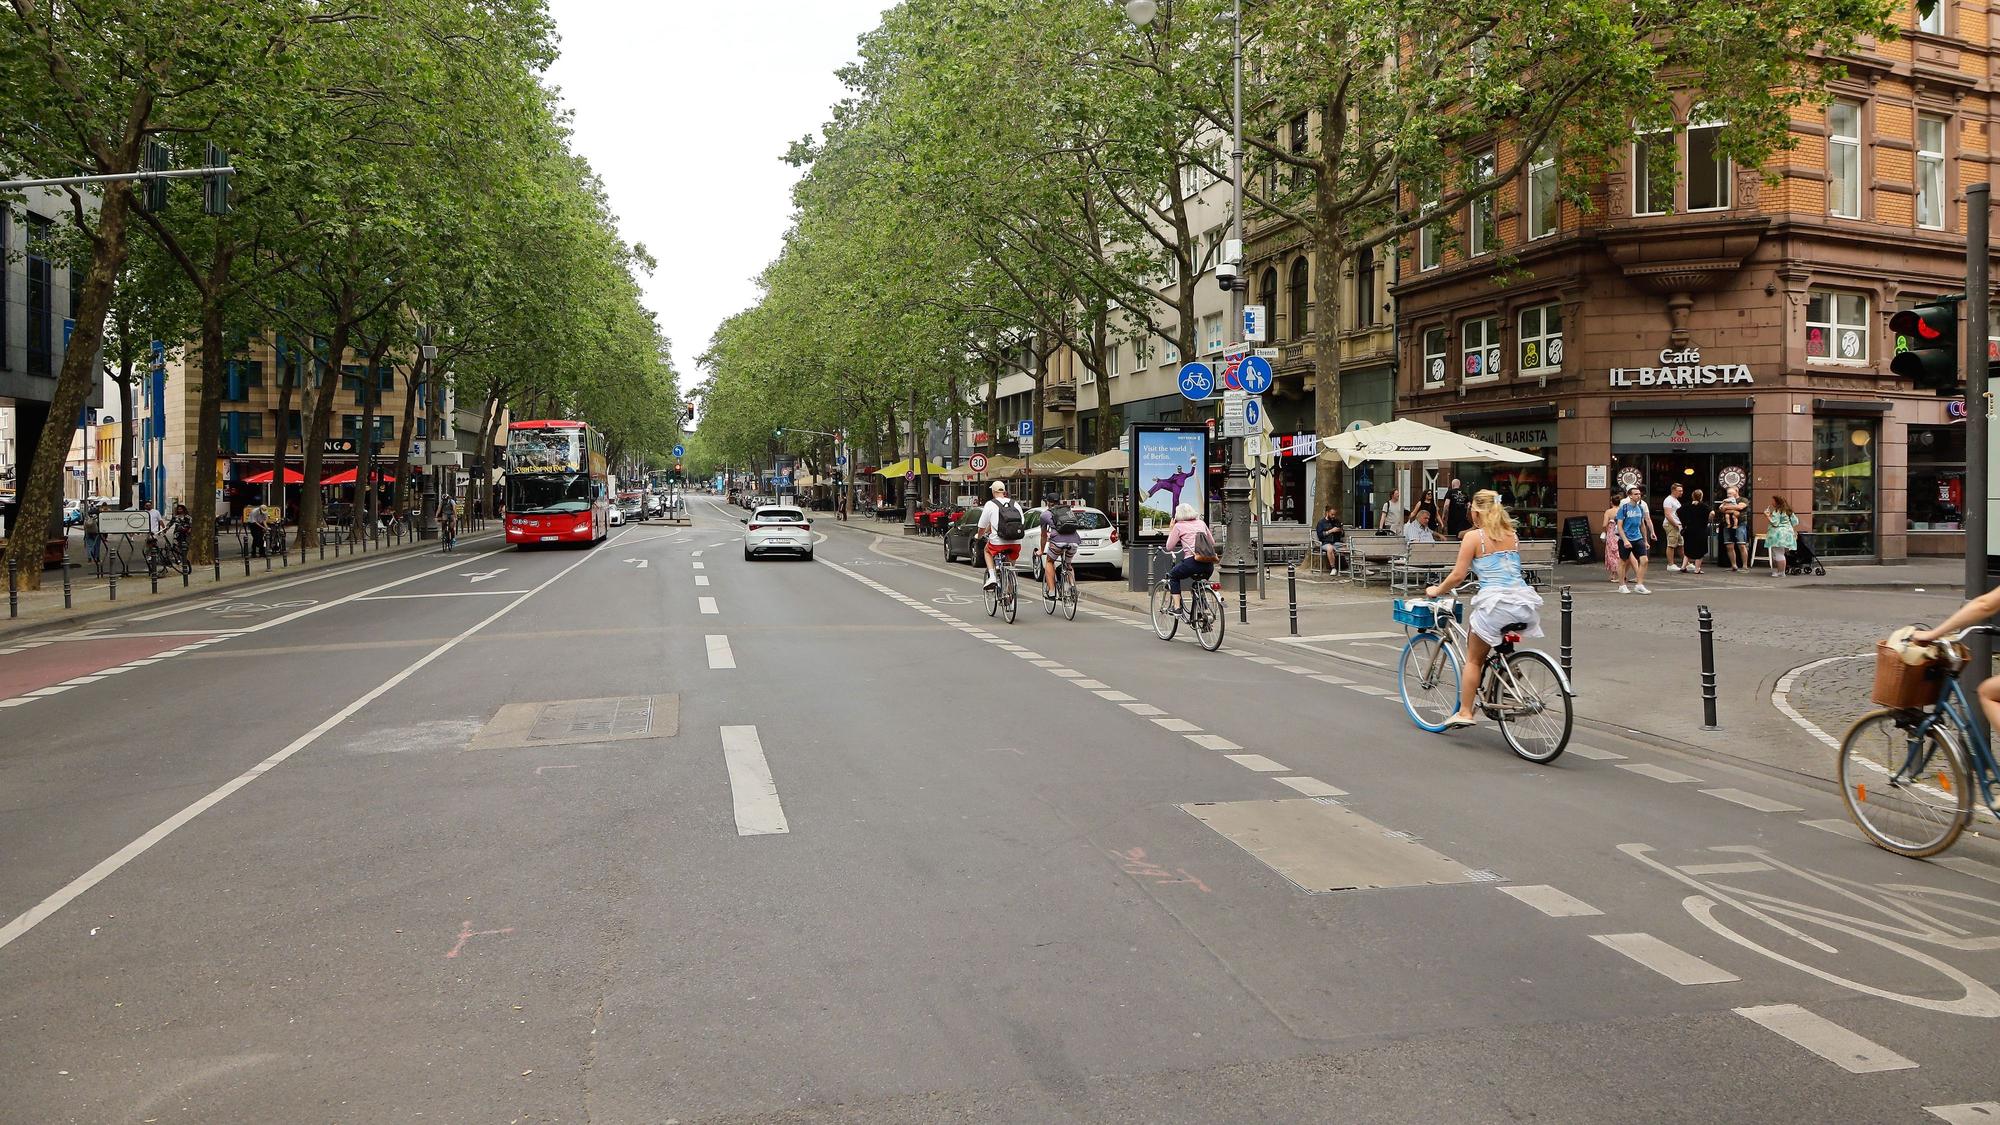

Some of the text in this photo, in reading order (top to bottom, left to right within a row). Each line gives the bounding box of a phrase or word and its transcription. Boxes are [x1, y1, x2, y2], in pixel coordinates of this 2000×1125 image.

[1660, 348, 1700, 364] Café
[1610, 364, 1755, 387] IL BARISTA
[1495, 431, 1504, 444] IL
[1506, 429, 1548, 443] BARISTA
[972, 458, 984, 468] 30
